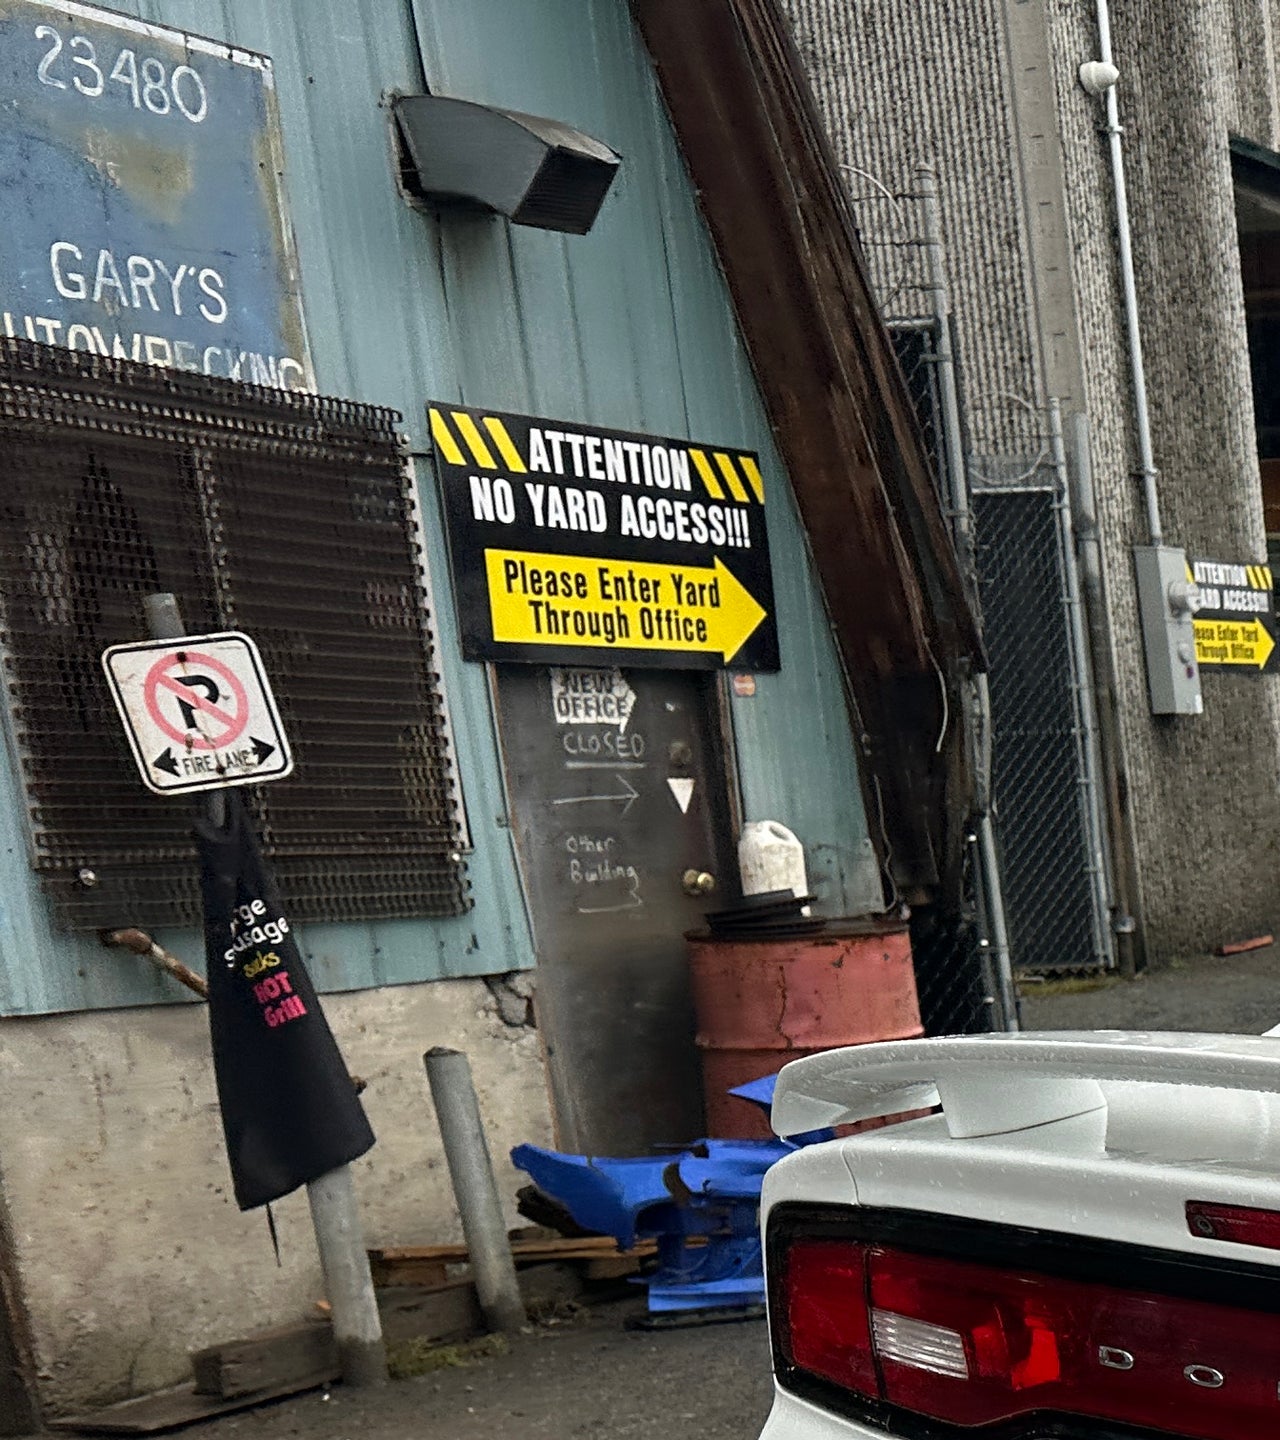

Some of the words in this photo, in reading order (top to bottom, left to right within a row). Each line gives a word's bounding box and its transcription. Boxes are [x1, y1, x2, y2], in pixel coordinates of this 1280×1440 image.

[35, 25, 208, 123] 23480
[50, 240, 229, 324] GARY'S
[529, 427, 692, 491] ATTENTION
[469, 475, 516, 524] NO
[525, 482, 608, 534] YARD
[621, 495, 751, 549] ACCESS!!!
[503, 558, 588, 599] Please
[597, 566, 661, 604] Enter
[671, 573, 721, 608] Yard
[1193, 561, 1248, 587] ATTENTION
[1199, 588, 1220, 610] ARD
[528, 600, 629, 643] Through
[640, 607, 708, 642] Office
[1194, 627, 1215, 641] ease
[182, 752, 215, 776] FIRE
[563, 731, 645, 758] CLOSED
